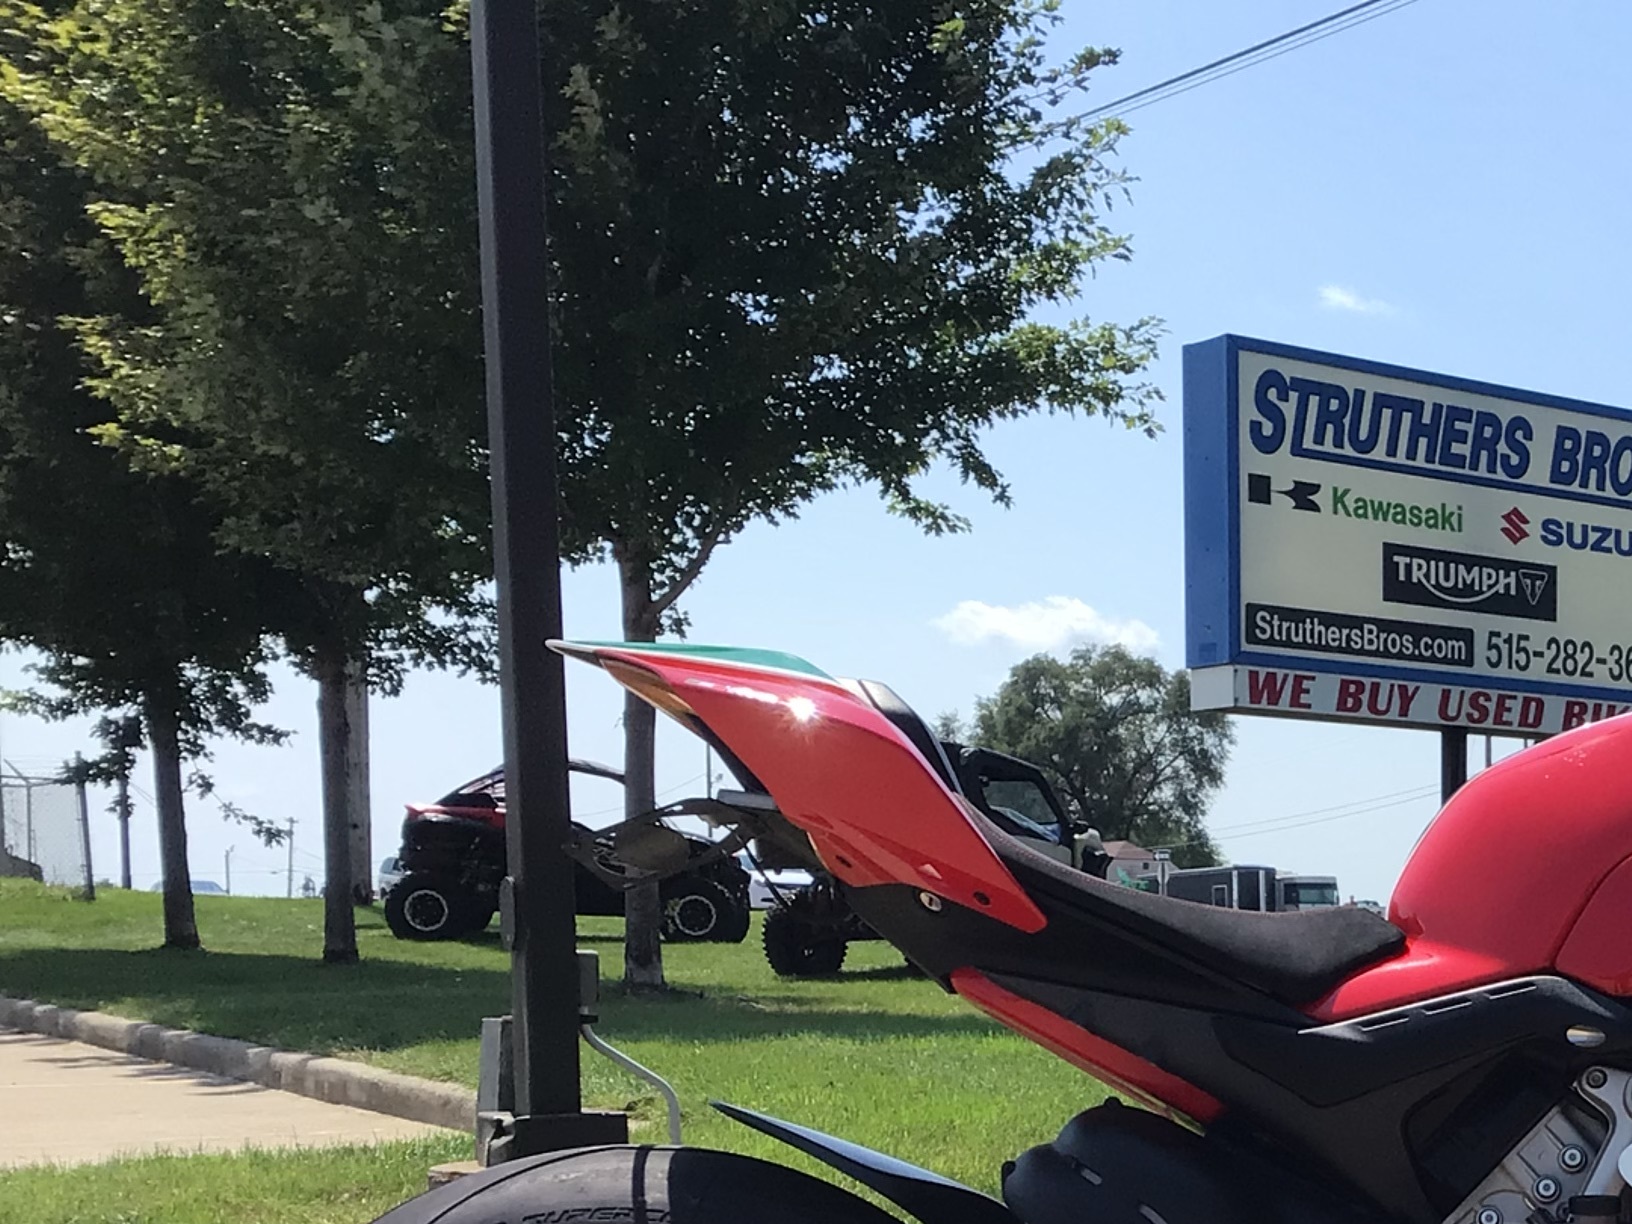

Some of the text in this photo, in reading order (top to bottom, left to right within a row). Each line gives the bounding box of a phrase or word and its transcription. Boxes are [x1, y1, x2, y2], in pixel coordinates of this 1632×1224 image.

[1249, 369, 1533, 480] STRUTHERS
[1331, 486, 1464, 534] Kawasaki
[1393, 555, 1517, 603] TRIUMPH
[1254, 611, 1467, 661] StruthersBros.com
[1248, 672, 1313, 708] WE
[1337, 680, 1419, 717] BUY
[1439, 691, 1544, 729] USED
